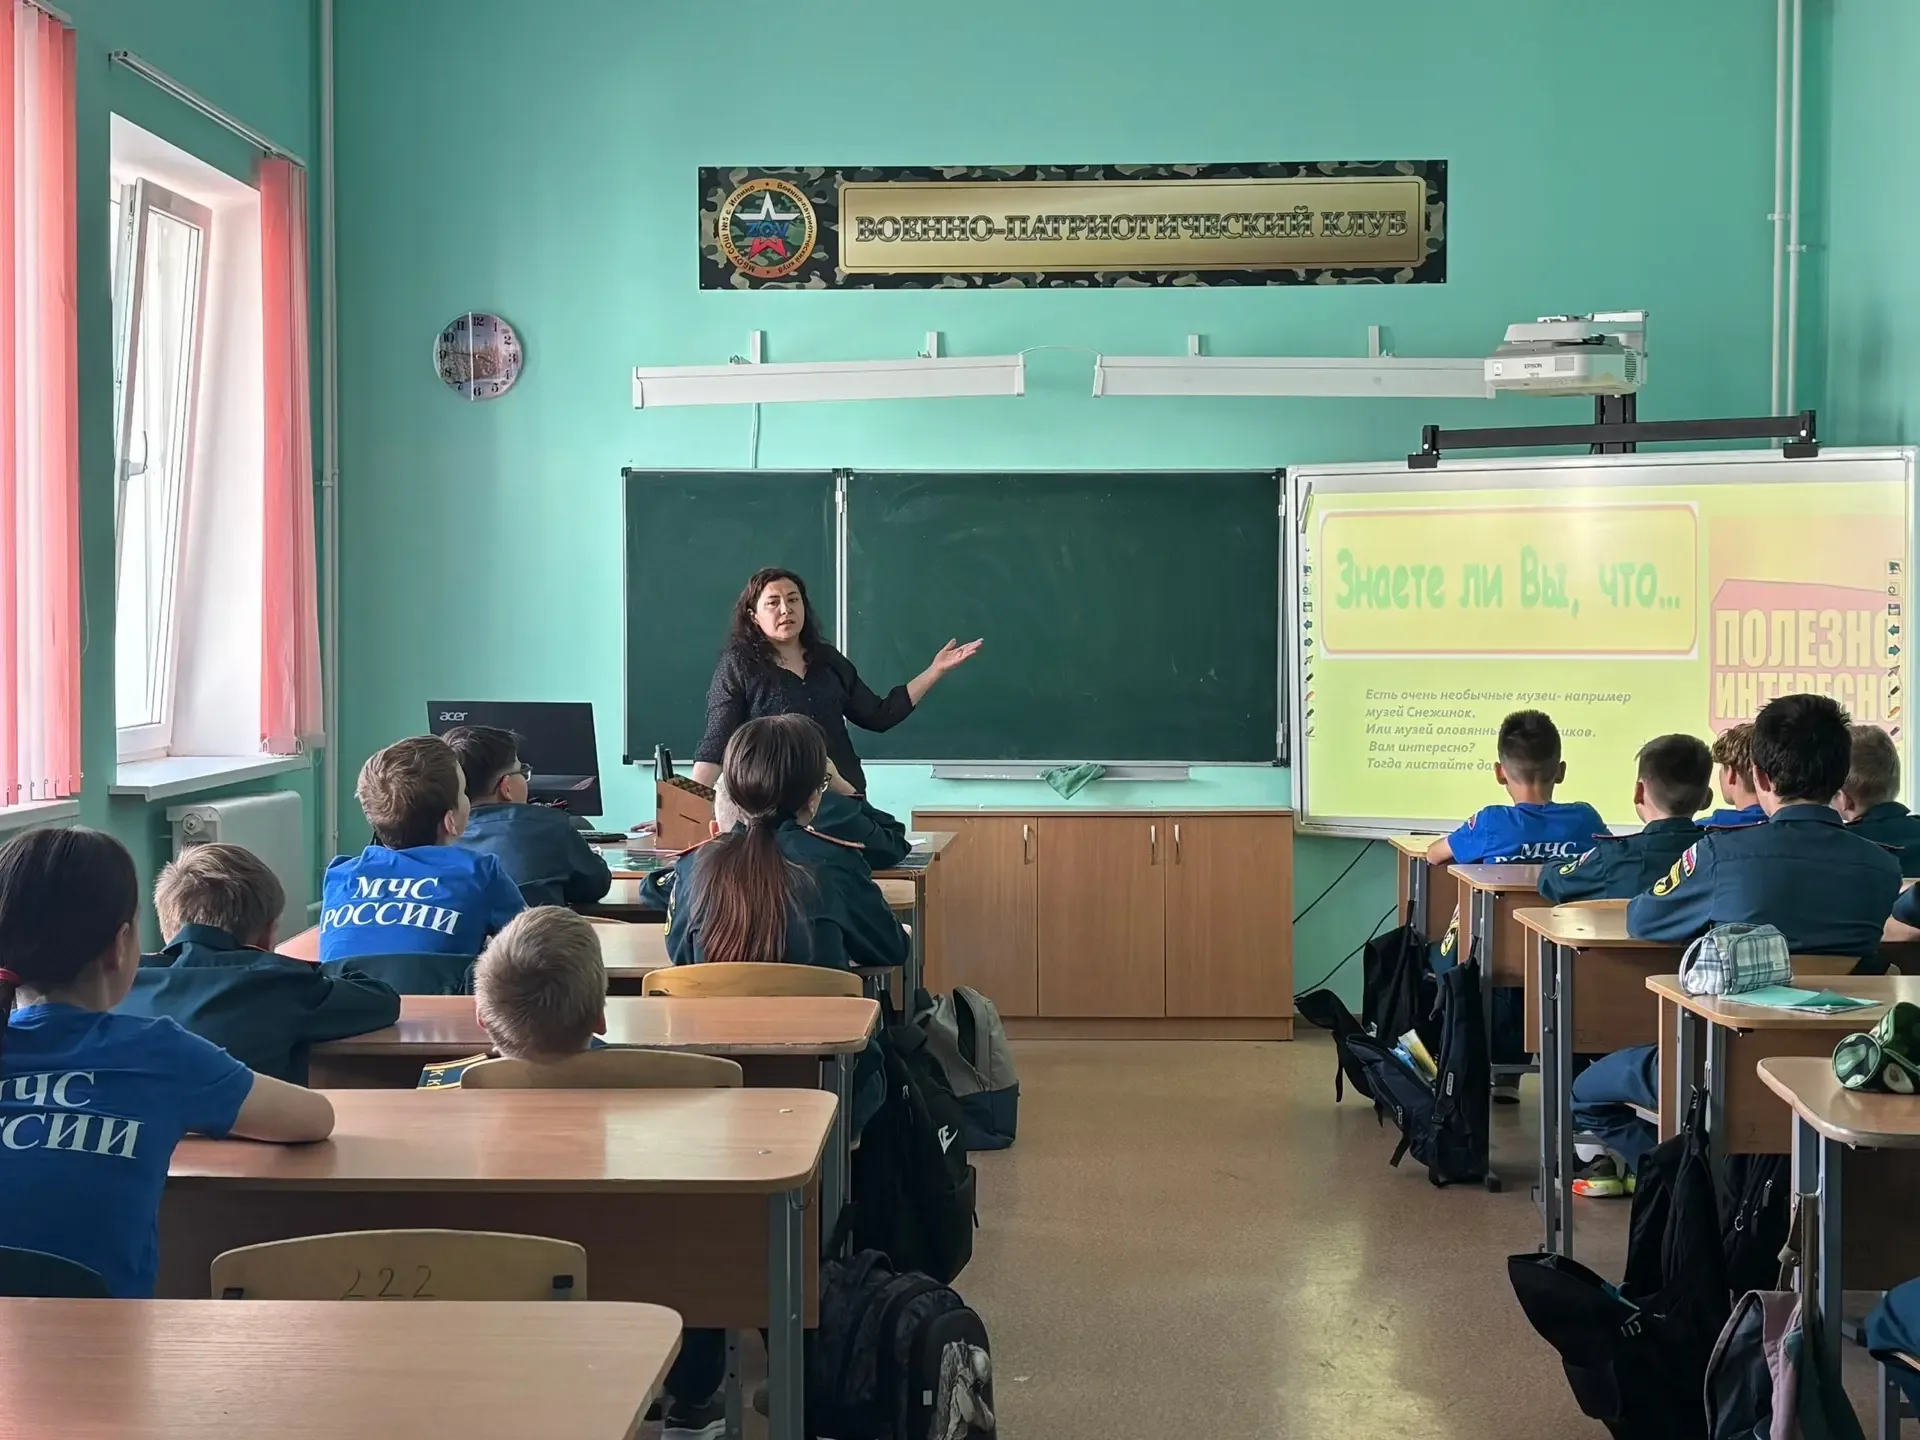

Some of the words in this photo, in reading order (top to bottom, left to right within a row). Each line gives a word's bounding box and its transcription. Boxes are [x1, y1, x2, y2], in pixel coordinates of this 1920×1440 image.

[855, 205, 1314, 242] ВОЕННО-ПАТРИОТИЧЕСКИЙ
[1320, 210, 1408, 238] КЛУБ
[721, 233, 735, 255] СОШ
[456, 321, 465, 331] 11
[473, 316, 485, 327] 12
[443, 332, 455, 343] 10
[504, 335, 512, 345] 2
[473, 386, 482, 397] 6
[1336, 547, 1446, 610] Знаете
[1459, 563, 1503, 609] ли
[1520, 544, 1580, 620] Вы,
[1599, 562, 1681, 609] что...
[1715, 608, 1899, 668] ПОЛЕЗНО
[1365, 689, 1398, 700] Есть
[1400, 691, 1437, 701] очень
[1440, 689, 1513, 702] необычные
[1564, 691, 1632, 705] например
[439, 711, 468, 721] acer
[1365, 705, 1404, 720] музей
[1406, 706, 1476, 719] Снежинок.
[1365, 723, 1392, 735] Или
[1394, 723, 1433, 737] музей
[1436, 726, 1500, 736] оловянны
[1369, 741, 1395, 752] Вам
[1398, 742, 1476, 756] интересно?
[1367, 758, 1401, 770] Тогда
[1405, 758, 1474, 771] листайте
[1521, 842, 1580, 858] МЧС
[351, 876, 439, 900] МЧС
[320, 902, 463, 935] РОССИИ
[0, 1071, 95, 1107] ЧС
[0, 1112, 145, 1159] СИИ
